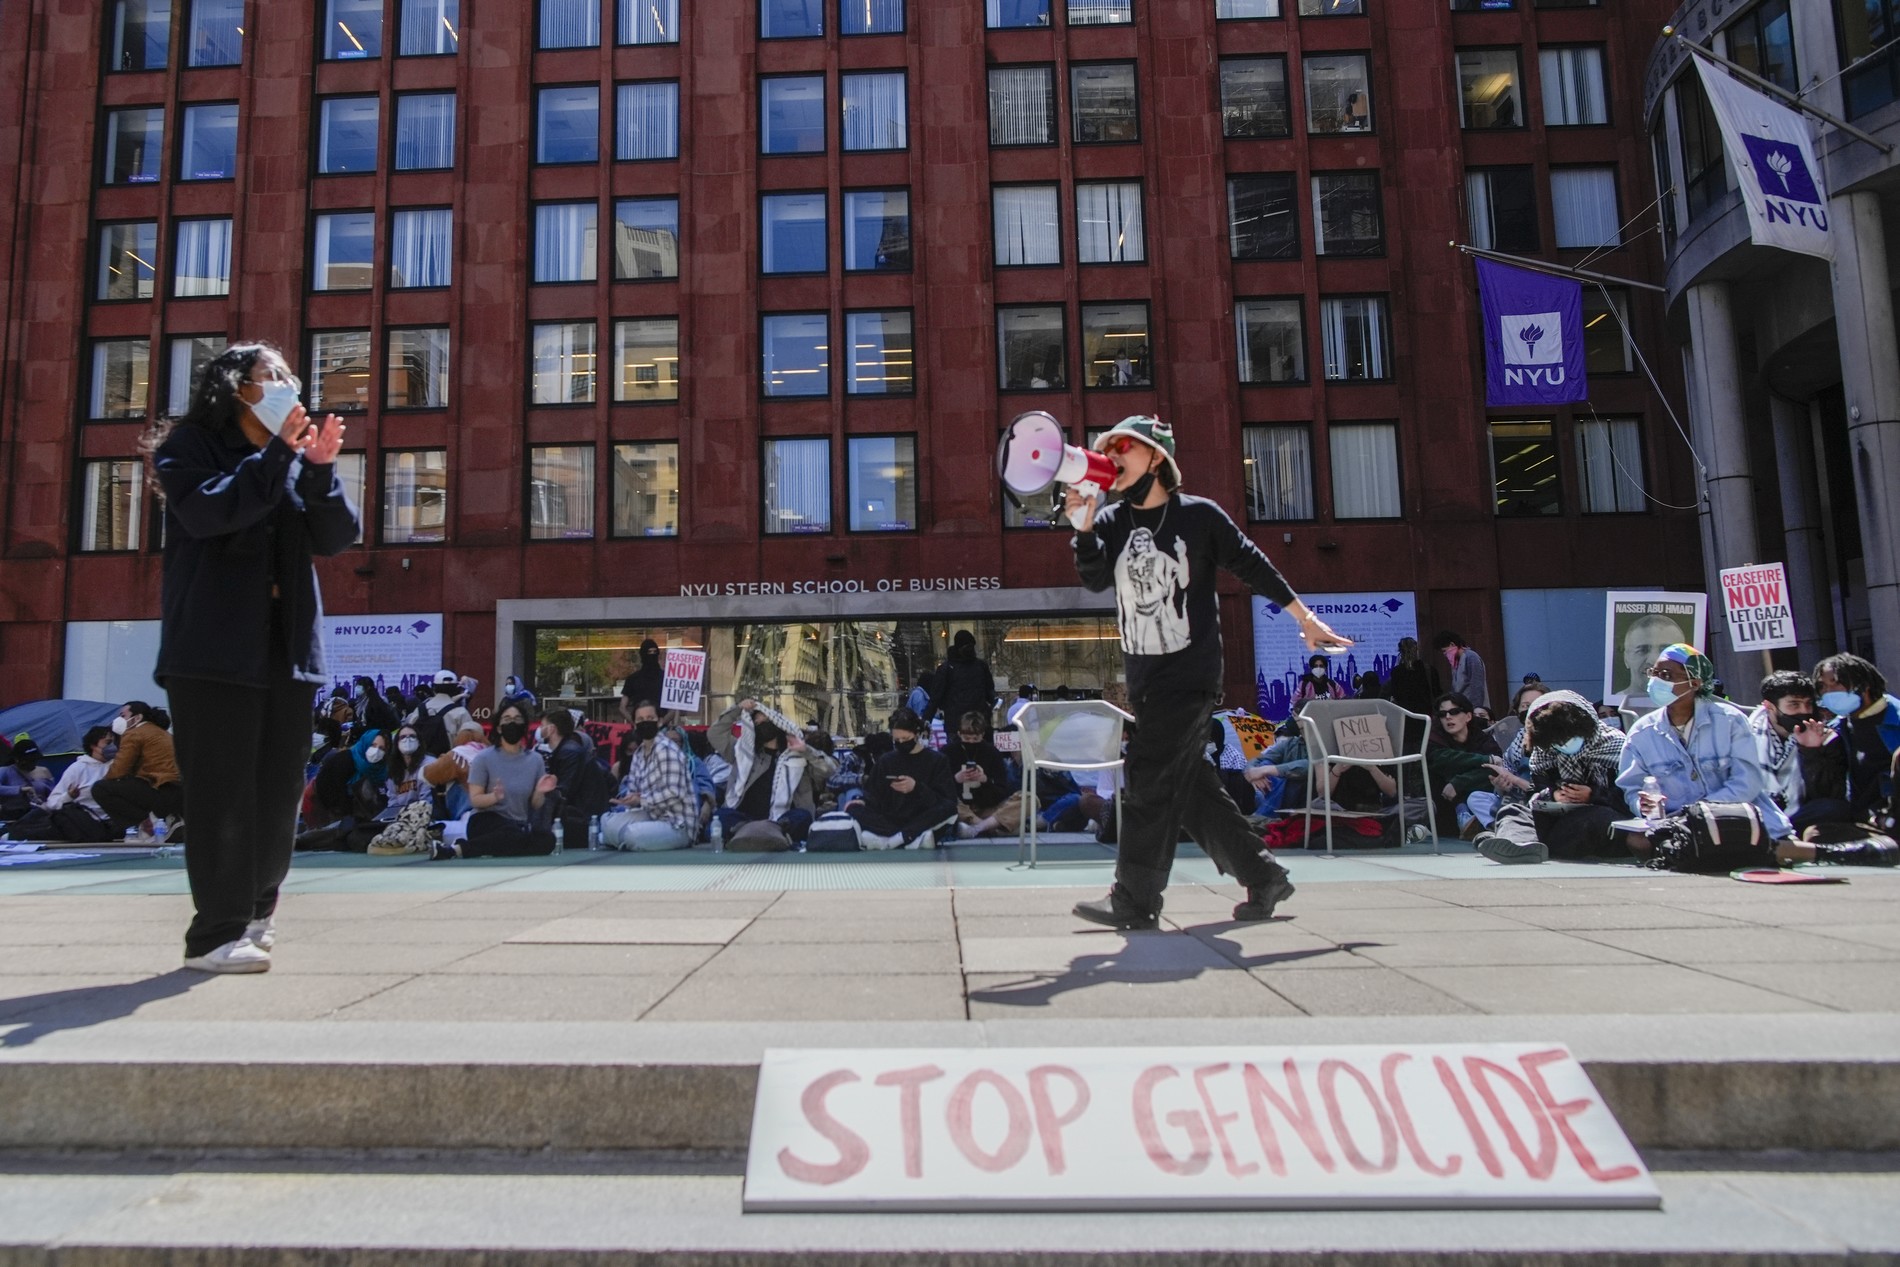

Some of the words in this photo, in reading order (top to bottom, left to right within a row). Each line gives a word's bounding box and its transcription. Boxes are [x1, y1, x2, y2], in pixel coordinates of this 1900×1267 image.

[1765, 199, 1828, 232] NYU
[1504, 367, 1565, 386] NYU
[1722, 568, 1782, 587] CEASEFIRE
[680, 583, 719, 597] NYU
[725, 582, 785, 596] STERN
[792, 580, 870, 595] SCHOOL
[876, 579, 902, 592] OF
[909, 577, 1001, 591] BUSINESS
[1728, 582, 1780, 609] NOW
[1305, 603, 1377, 614] TERN2024
[1615, 603, 1646, 613] NASSER
[1647, 604, 1664, 614] ABU
[1665, 604, 1694, 615] HMAID
[1730, 608, 1751, 623] LET
[1754, 605, 1789, 621] GAZA
[335, 625, 402, 636] #NYU2024
[1738, 620, 1784, 642] LIVE!
[667, 652, 703, 665] CEASEFIRE
[667, 662, 700, 681] NOW
[665, 678, 678, 688] LET
[679, 680, 700, 691] GAZA
[667, 689, 694, 704] LIVE!
[472, 707, 491, 719] 40
[1340, 717, 1371, 738] NYU
[995, 733, 1012, 742] FREE
[995, 741, 1022, 751] PALEST
[777, 1063, 1091, 1186] STOP
[1132, 1049, 1640, 1182] GENOCIDE
